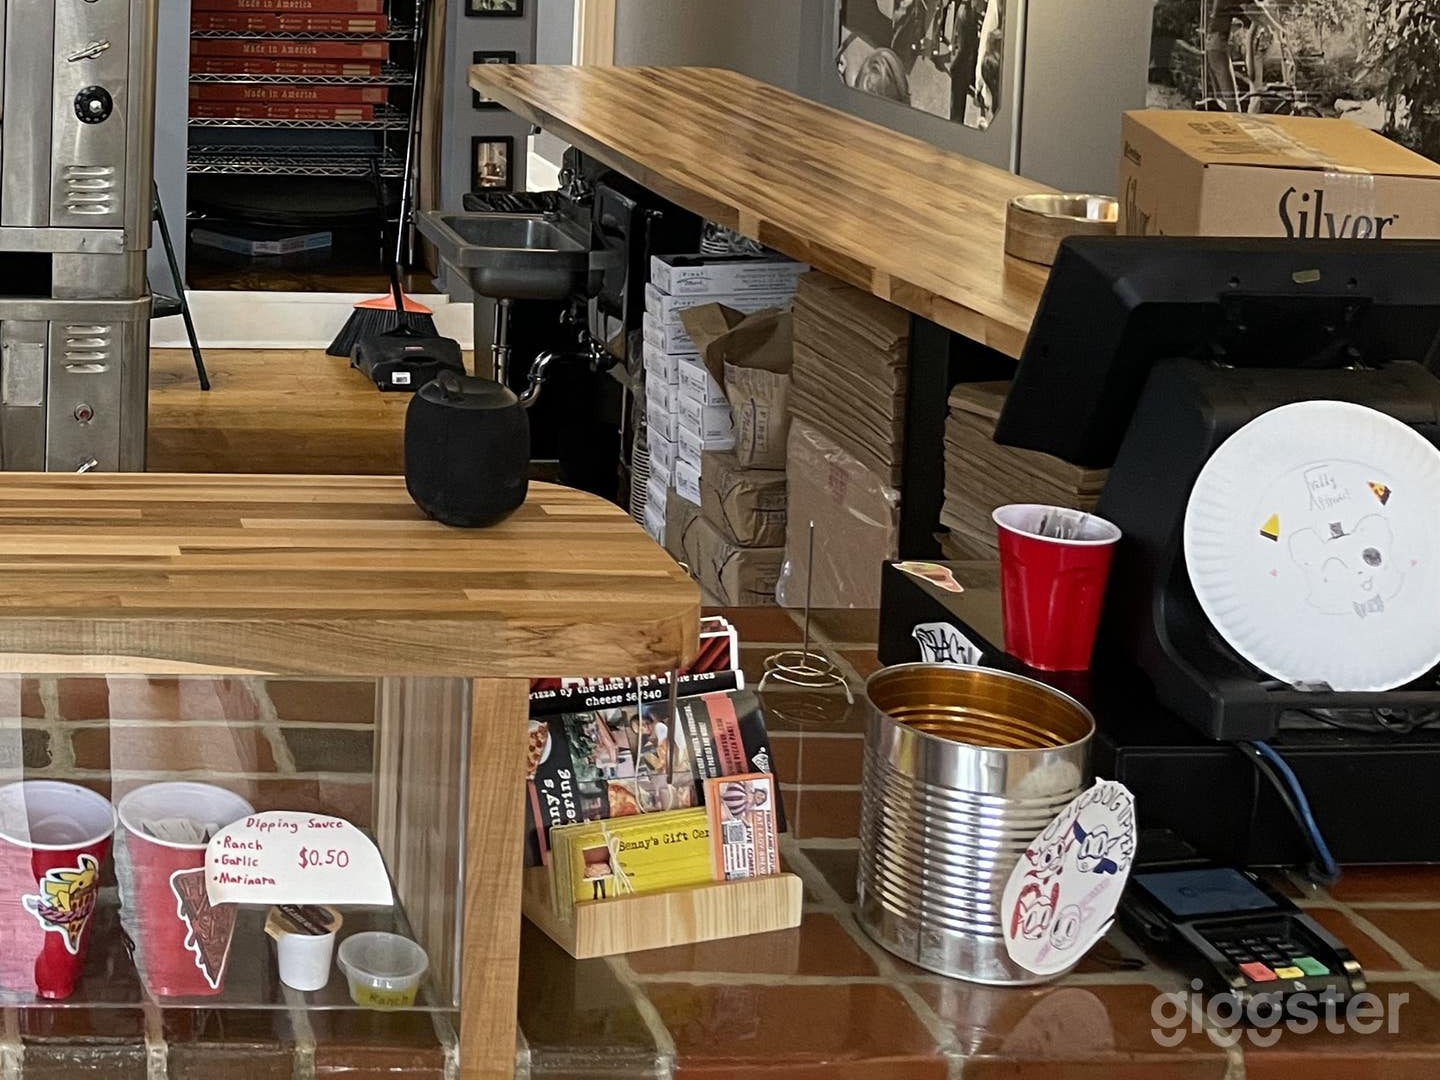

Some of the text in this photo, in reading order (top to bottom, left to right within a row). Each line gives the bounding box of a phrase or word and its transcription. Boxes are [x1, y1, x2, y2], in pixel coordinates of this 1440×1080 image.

[263, 0, 273, 8] in
[276, 0, 312, 9] America
[243, 44, 317, 54] Made in America
[244, 89, 317, 99] Made in America
[585, 694, 623, 707] Cheese
[541, 779, 560, 826] nny's
[557, 769, 577, 823] ering
[246, 818, 343, 834] Dipping Sauce
[224, 835, 263, 850] Ranch
[663, 832, 688, 844] Gift
[221, 854, 259, 867] Garlic
[298, 846, 349, 869] $0.50
[218, 872, 276, 885] Marinara
